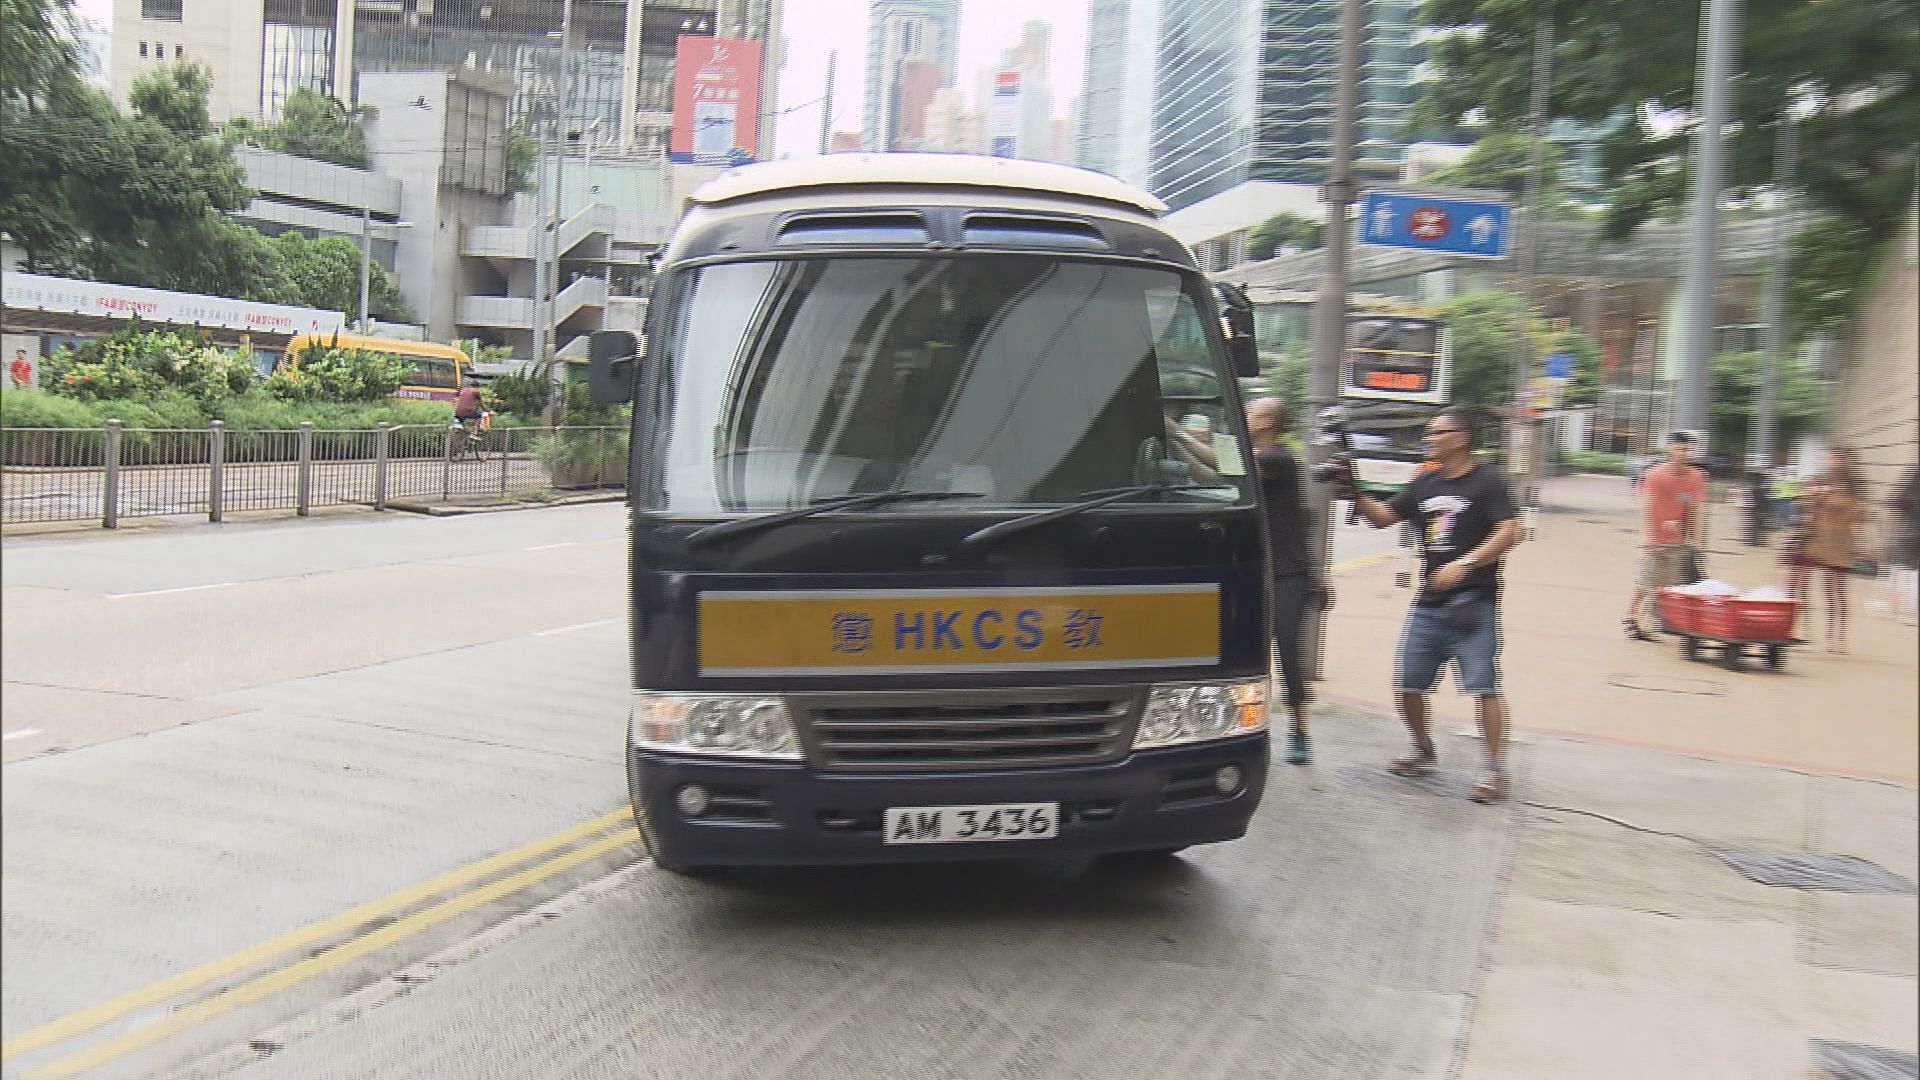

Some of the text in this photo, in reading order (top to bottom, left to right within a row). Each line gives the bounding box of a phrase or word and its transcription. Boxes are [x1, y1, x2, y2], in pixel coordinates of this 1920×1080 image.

[893, 609, 1044, 649] HKCS
[893, 809, 1050, 839] AM 3436
